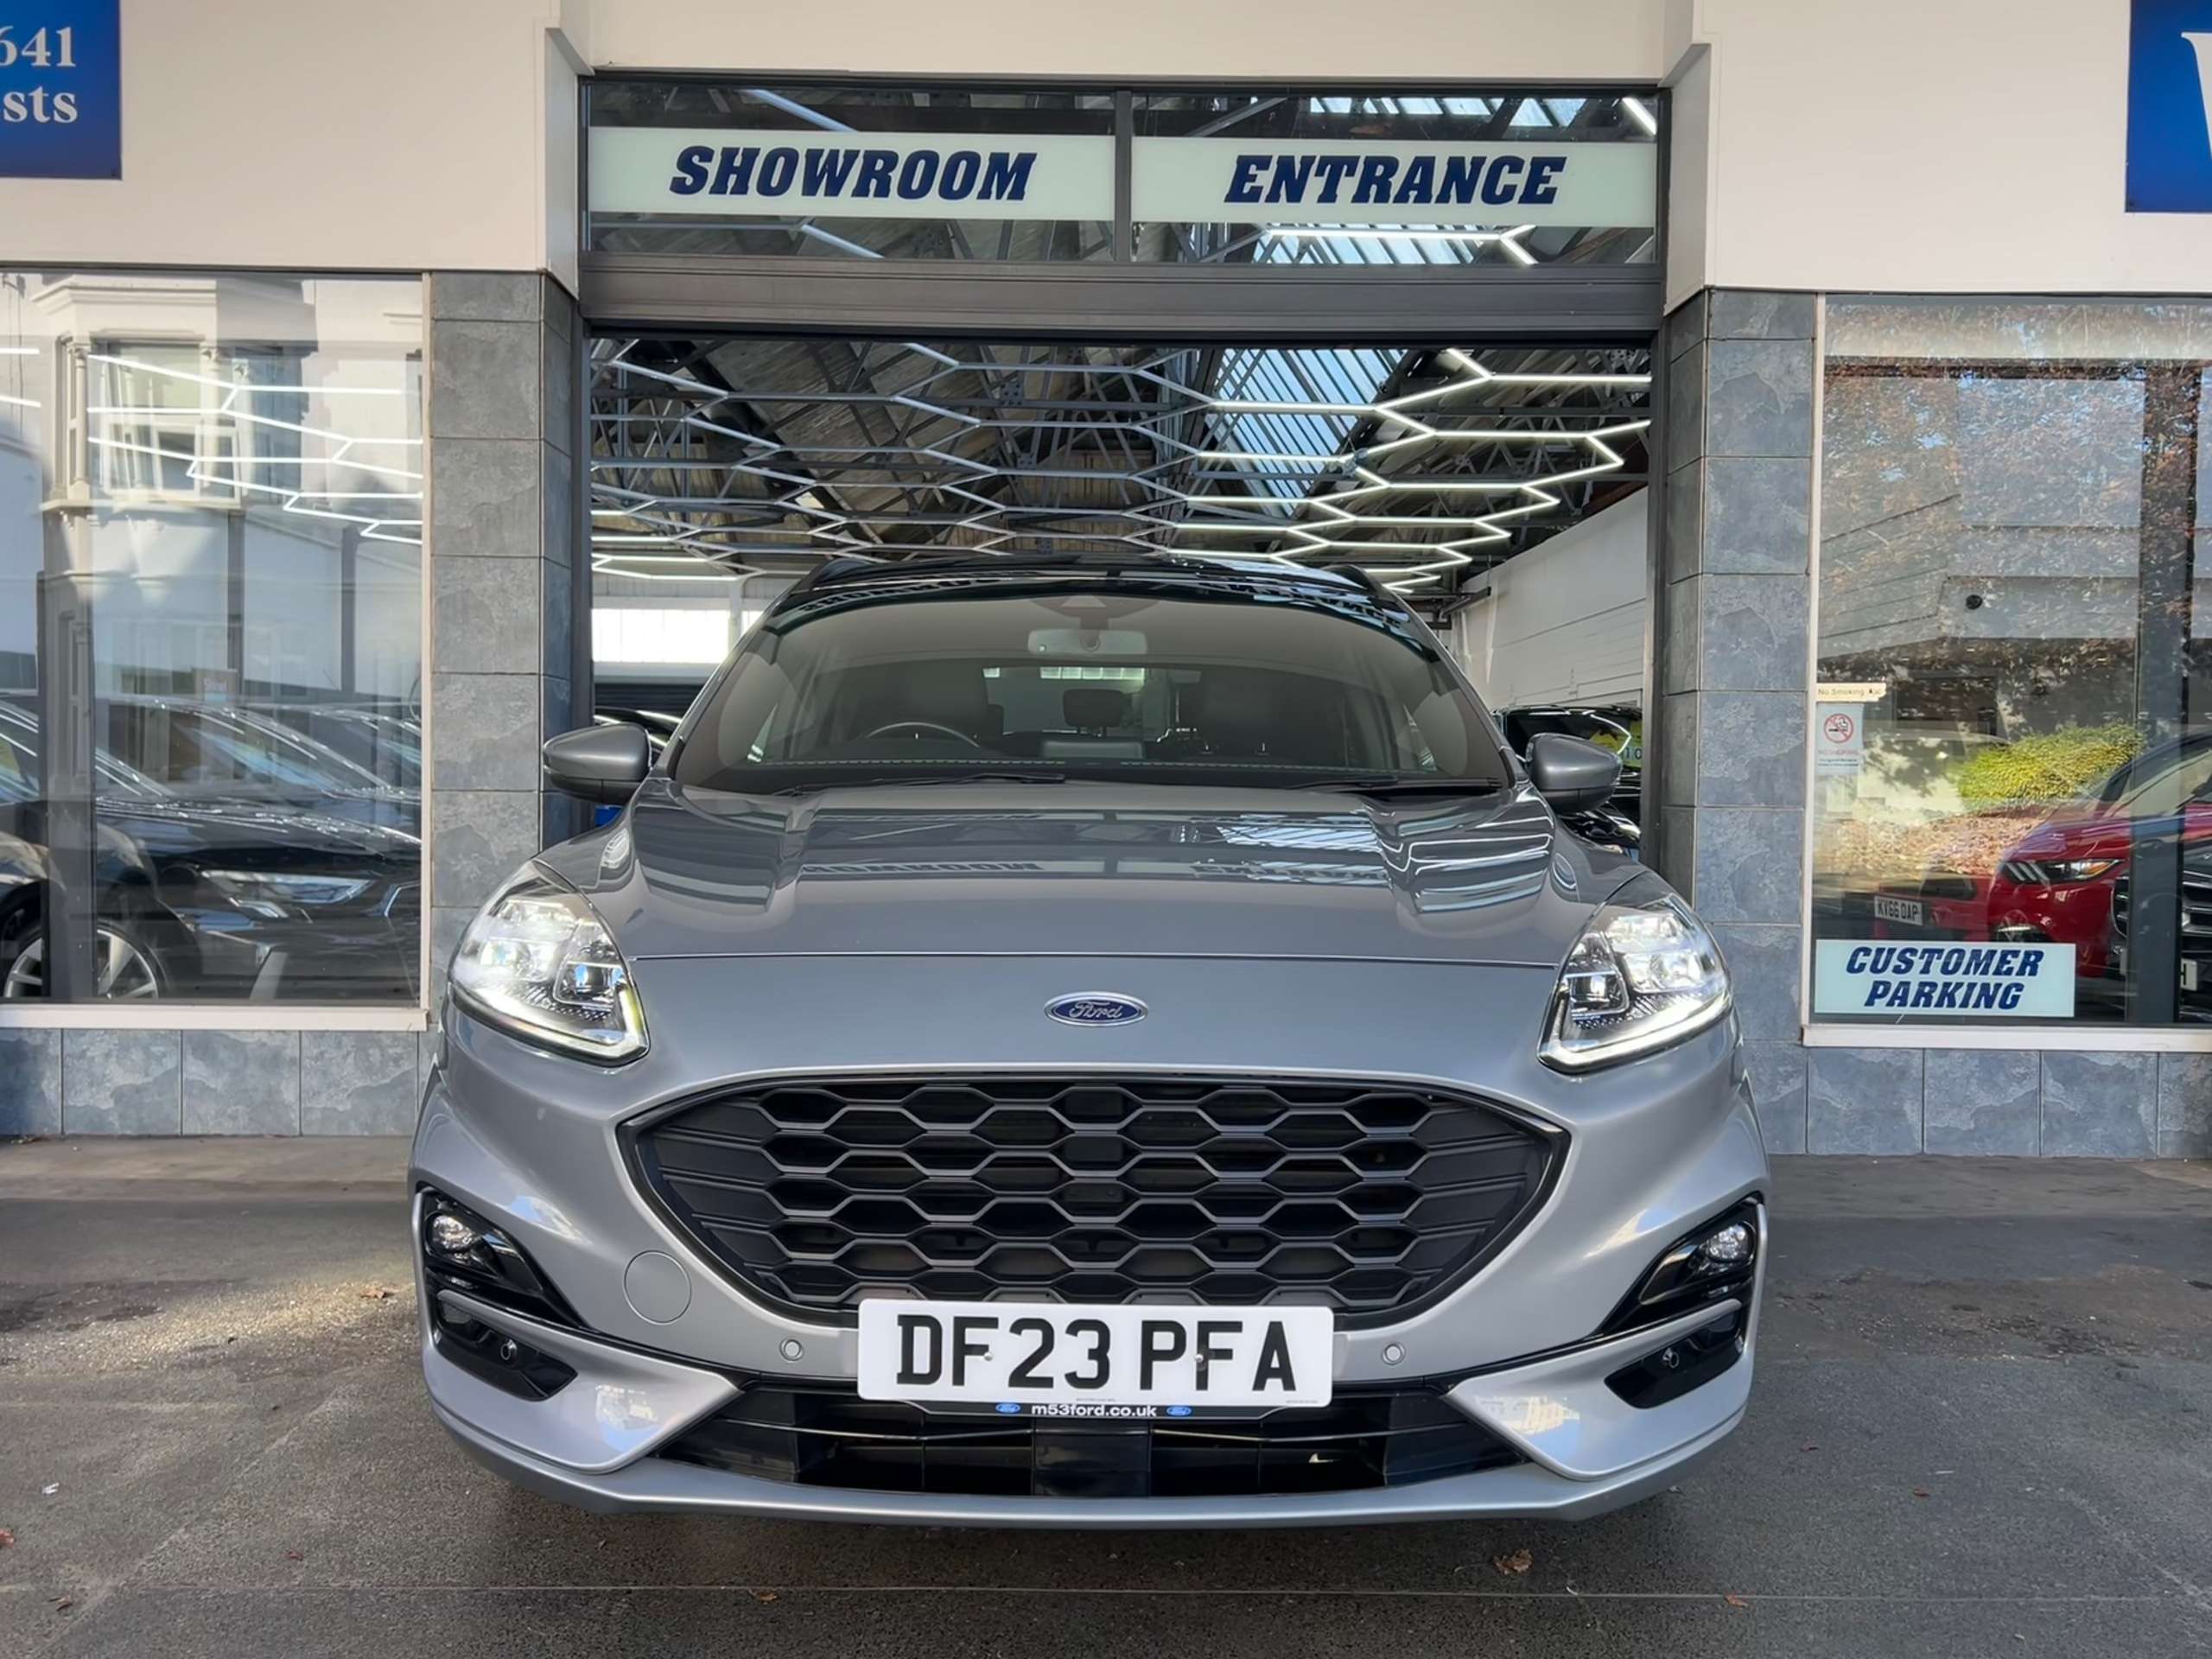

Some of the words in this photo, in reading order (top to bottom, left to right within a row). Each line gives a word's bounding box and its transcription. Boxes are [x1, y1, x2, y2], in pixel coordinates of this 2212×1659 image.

[3, 86, 78, 124] sts
[669, 145, 1037, 200] SHOWROOM
[1224, 155, 1567, 205] ENTRANCE
[1846, 946, 2044, 977] CUSTOMER
[1069, 1001, 1122, 1018] Ford
[1864, 980, 2024, 1010] PARKING
[896, 1314, 1110, 1389] DF23
[1139, 1319, 1296, 1392] PFA
[1032, 1403, 1157, 1417] m53ford.co.uk
